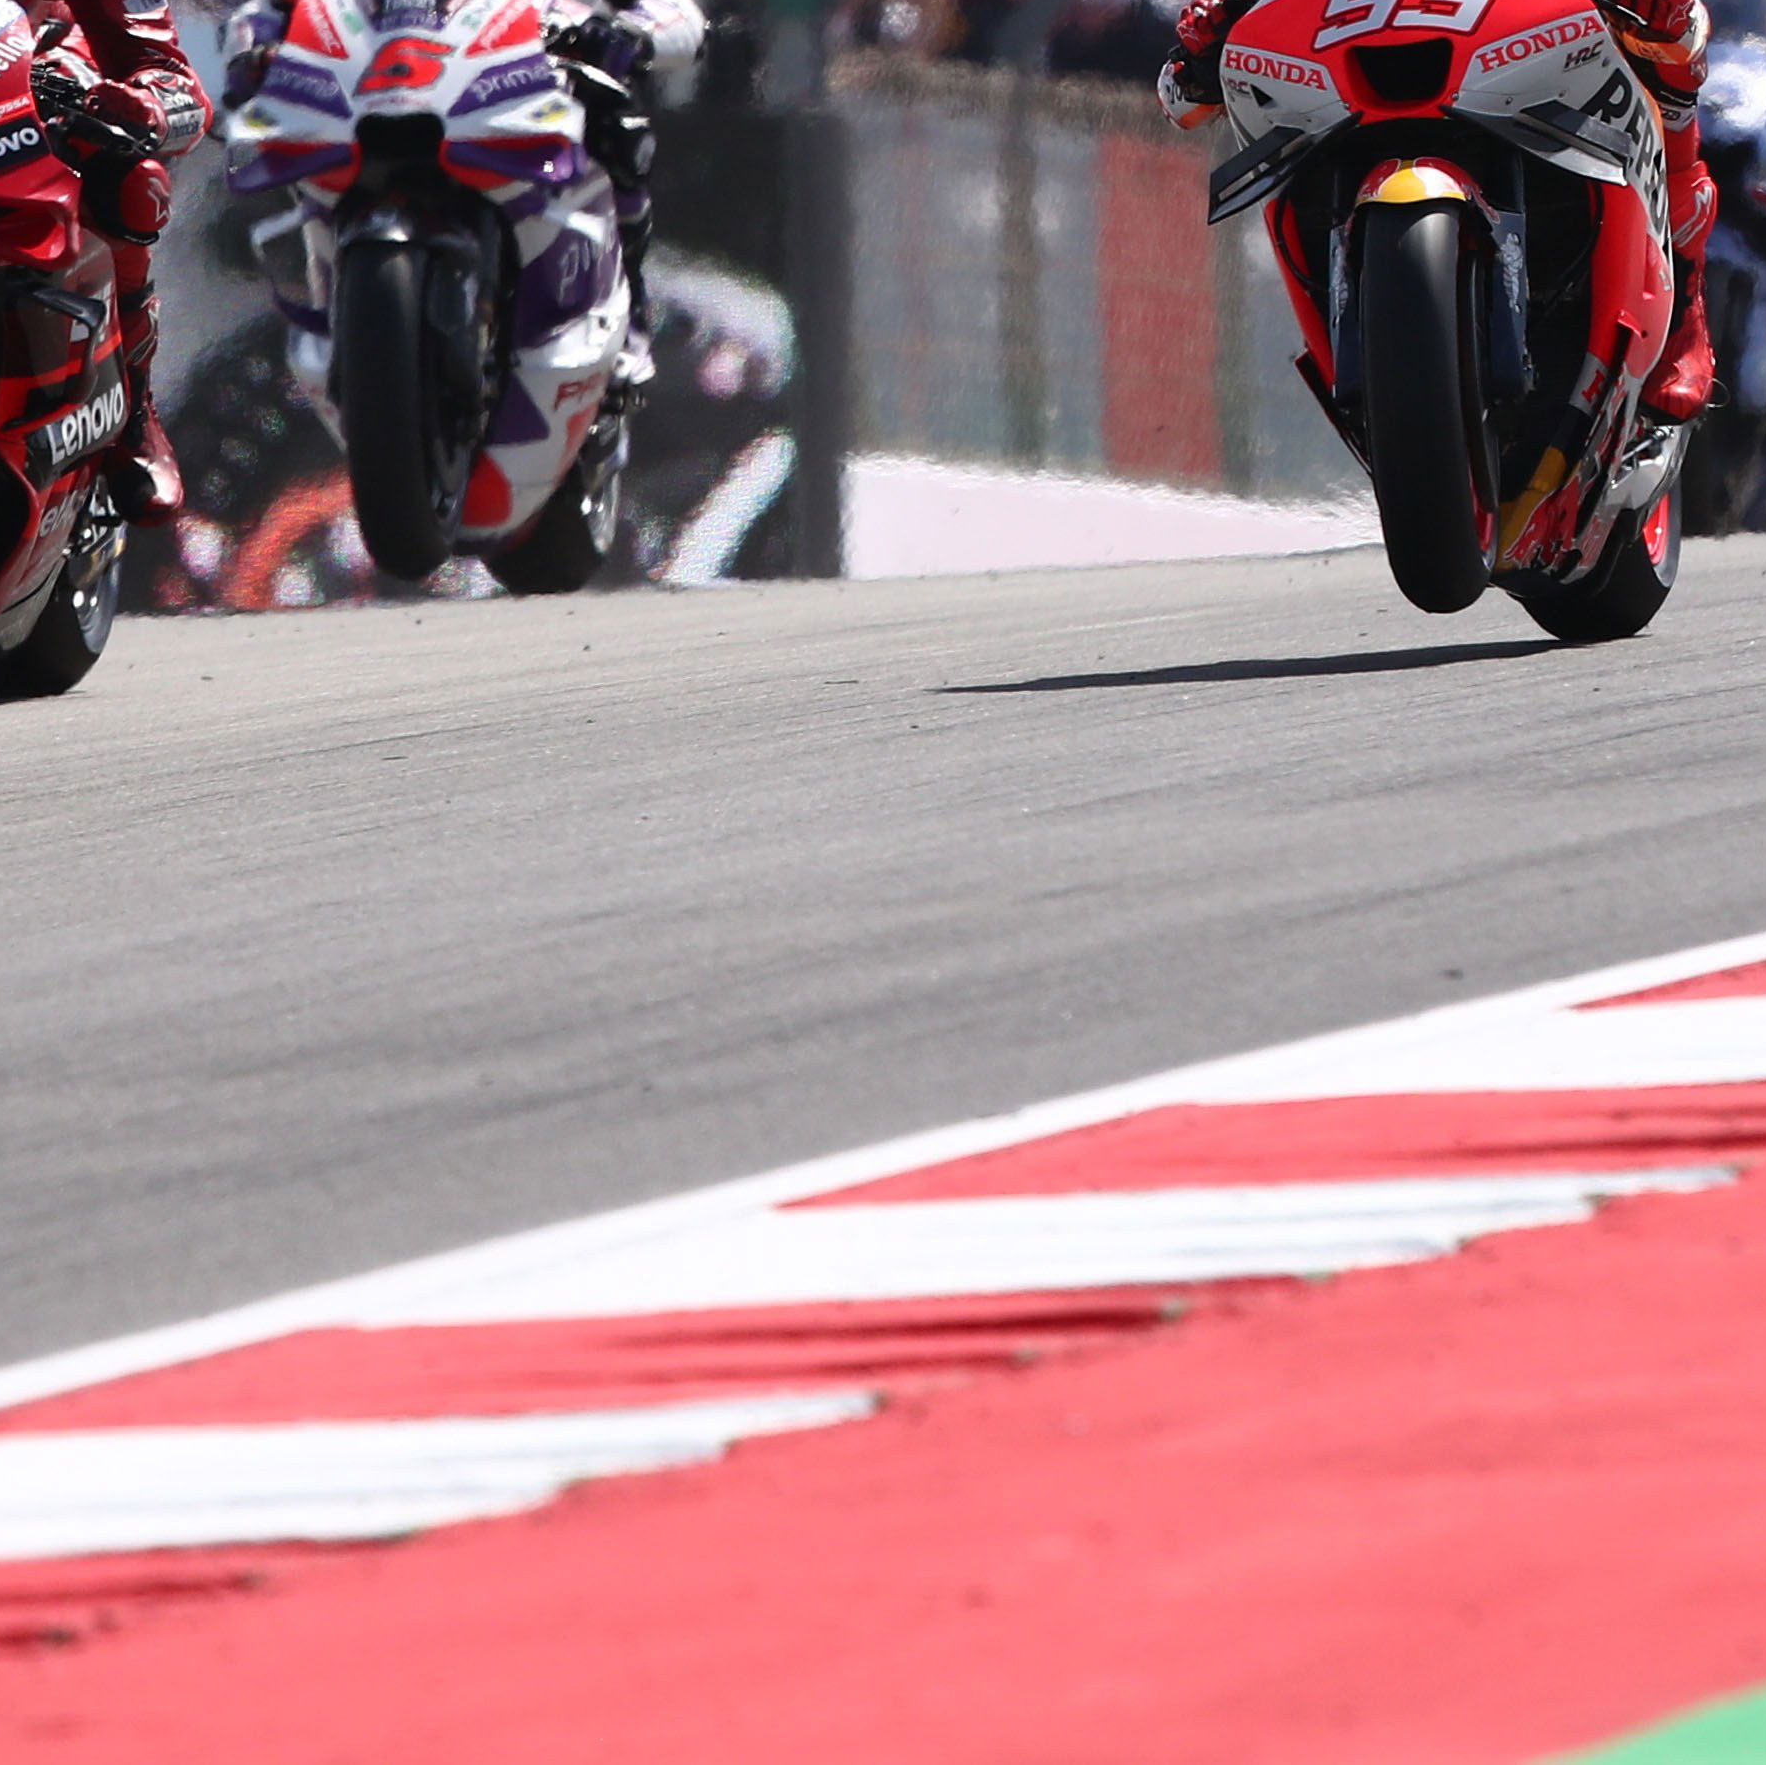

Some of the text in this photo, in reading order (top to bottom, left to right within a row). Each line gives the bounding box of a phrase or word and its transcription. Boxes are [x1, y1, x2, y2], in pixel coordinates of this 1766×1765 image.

[1224, 48, 1328, 92] HONDA
[1476, 15, 1606, 74] HONDA
[1563, 39, 1605, 70] HRC
[45, 381, 125, 466] Lenovo
